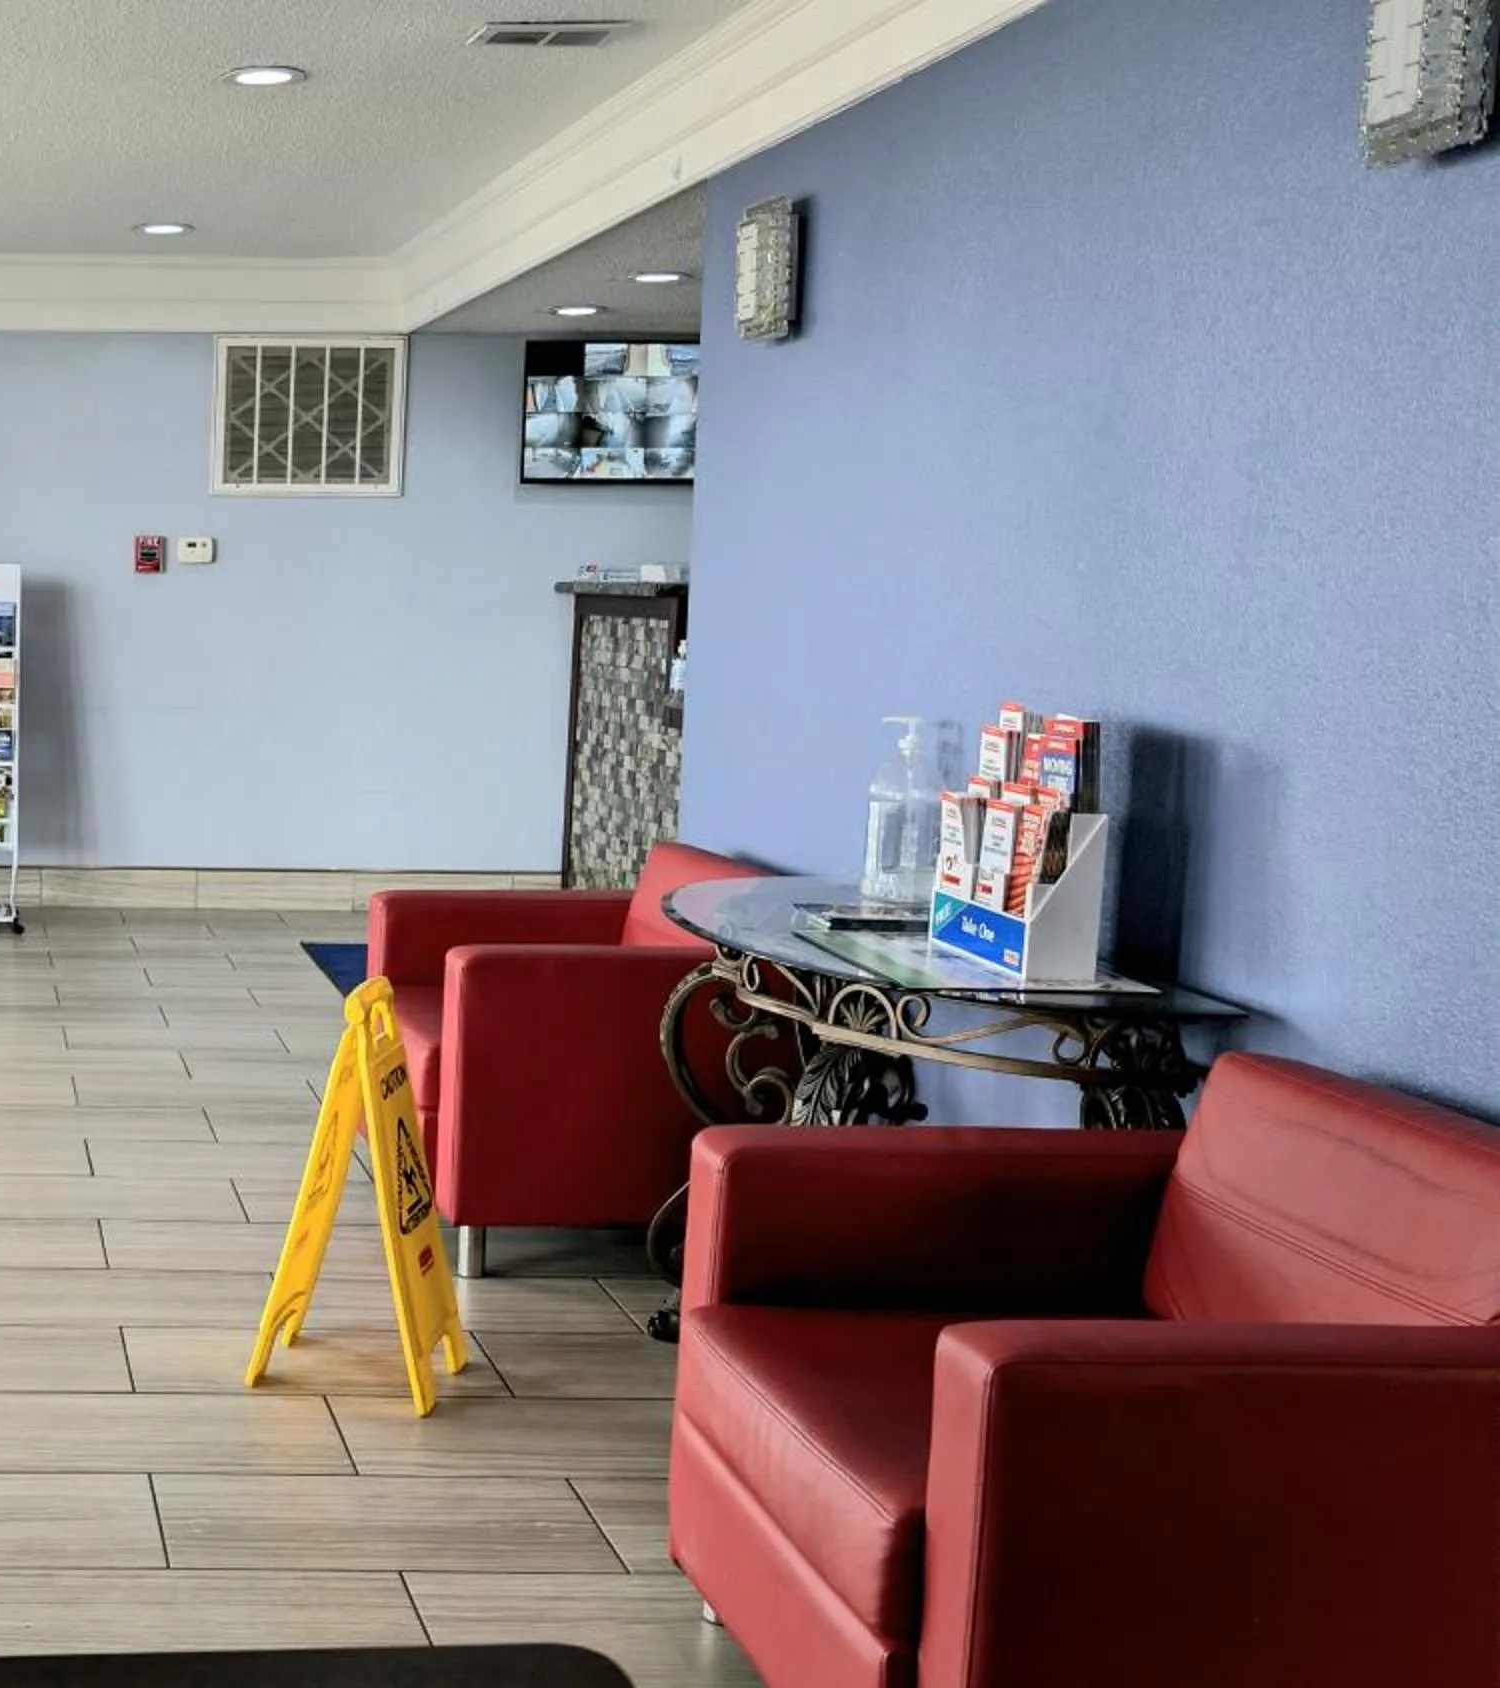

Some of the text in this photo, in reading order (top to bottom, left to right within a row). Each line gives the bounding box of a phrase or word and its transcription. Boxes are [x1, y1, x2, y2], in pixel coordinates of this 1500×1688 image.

[961, 915, 995, 942] Take One
[380, 1062, 407, 1100] CAUTION
